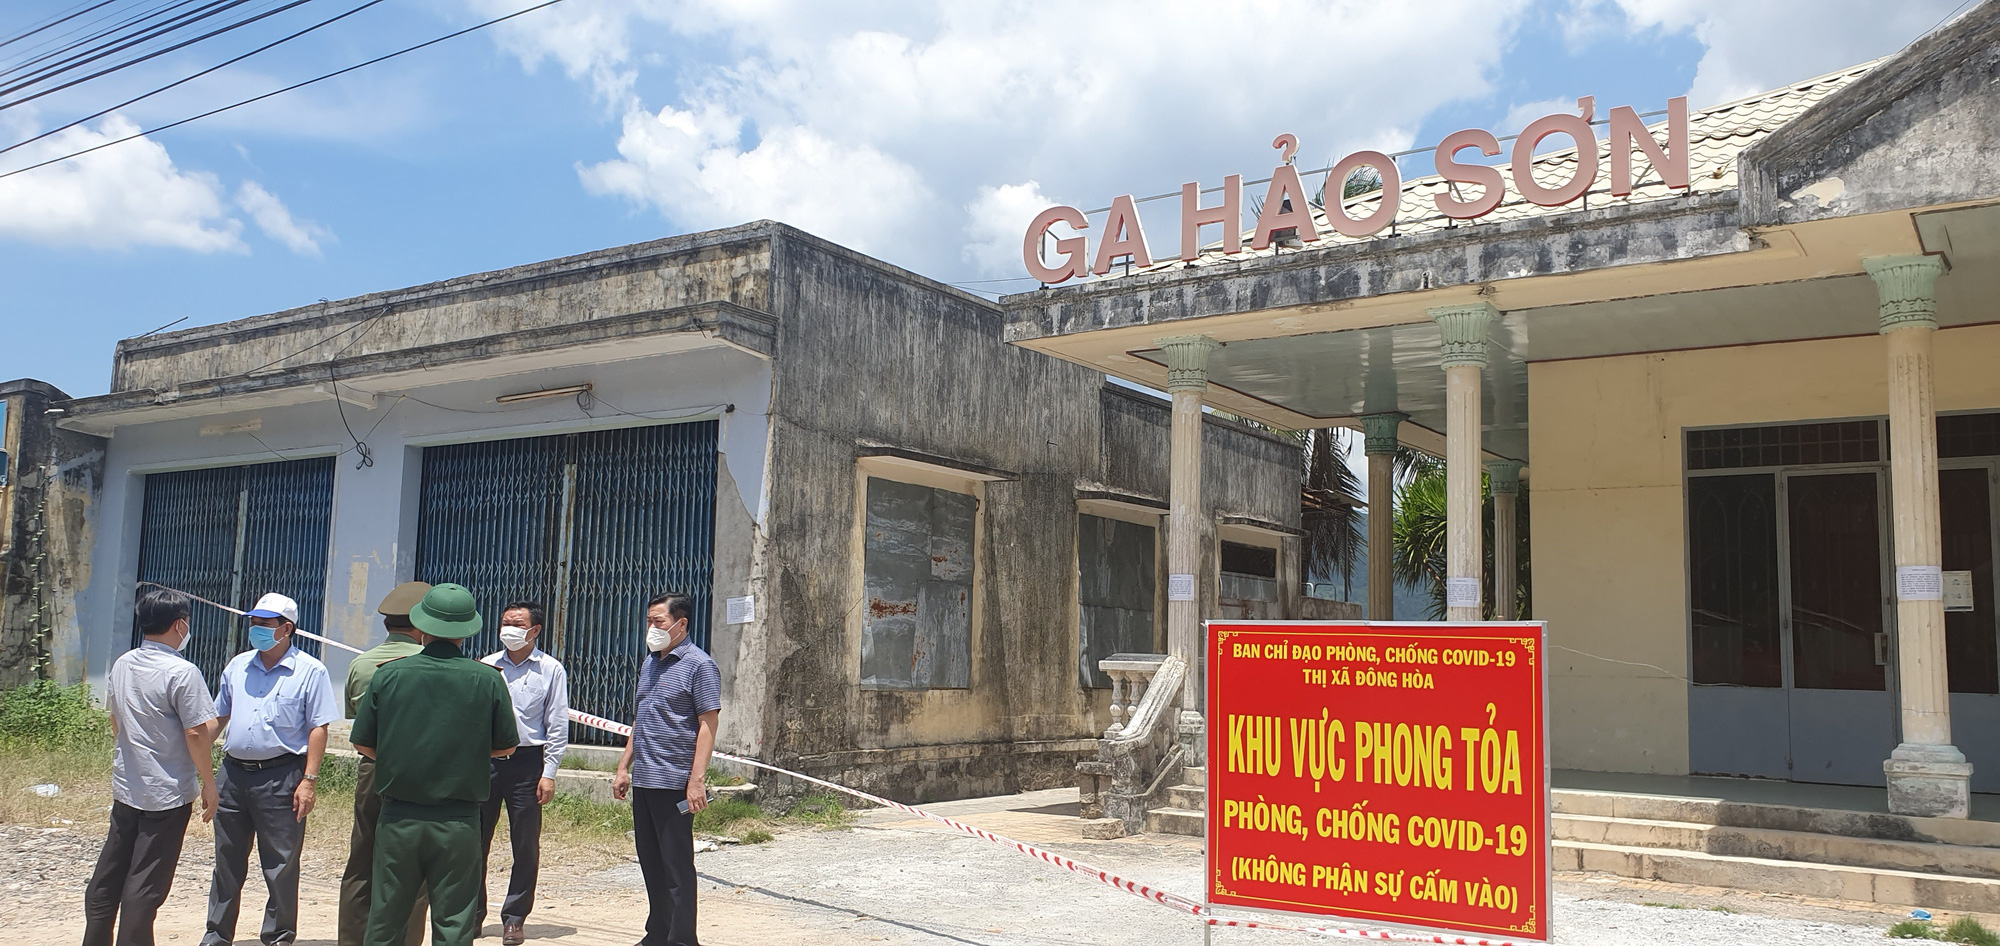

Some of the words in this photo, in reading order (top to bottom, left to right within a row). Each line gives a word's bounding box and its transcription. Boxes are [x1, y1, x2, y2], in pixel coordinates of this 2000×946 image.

[1023, 194, 1153, 284] GA
[1181, 133, 1402, 261] HẢO
[1433, 95, 1690, 220] SƠN
[1233, 642, 1261, 659] BAN
[1264, 640, 1288, 660] CHỈ
[1292, 644, 1322, 662] ĐẠO
[1326, 642, 1381, 665] PHÒNG,
[1385, 643, 1438, 665] CHỐNG
[1442, 648, 1516, 667] COVID-19
[1302, 668, 1327, 688] THỊ
[1331, 667, 1350, 686] XÃ
[1356, 667, 1398, 688] ĐÔNG
[1402, 669, 1434, 689] HÒA
[1228, 714, 1281, 777] KHU
[1289, 707, 1346, 793] VỰC
[1355, 721, 1452, 791] PHONG
[1461, 702, 1522, 795] TỎA
[1223, 795, 1308, 841] PHÒNG,
[1316, 800, 1400, 845] CHỐNG
[1407, 815, 1528, 857] COVID-19
[1231, 855, 1306, 887] (KHÔNG
[1312, 863, 1368, 896] PHẬN
[1374, 869, 1405, 902] SỰ
[1409, 869, 1458, 904] CẤM
[1465, 876, 1518, 914] VÀO)
